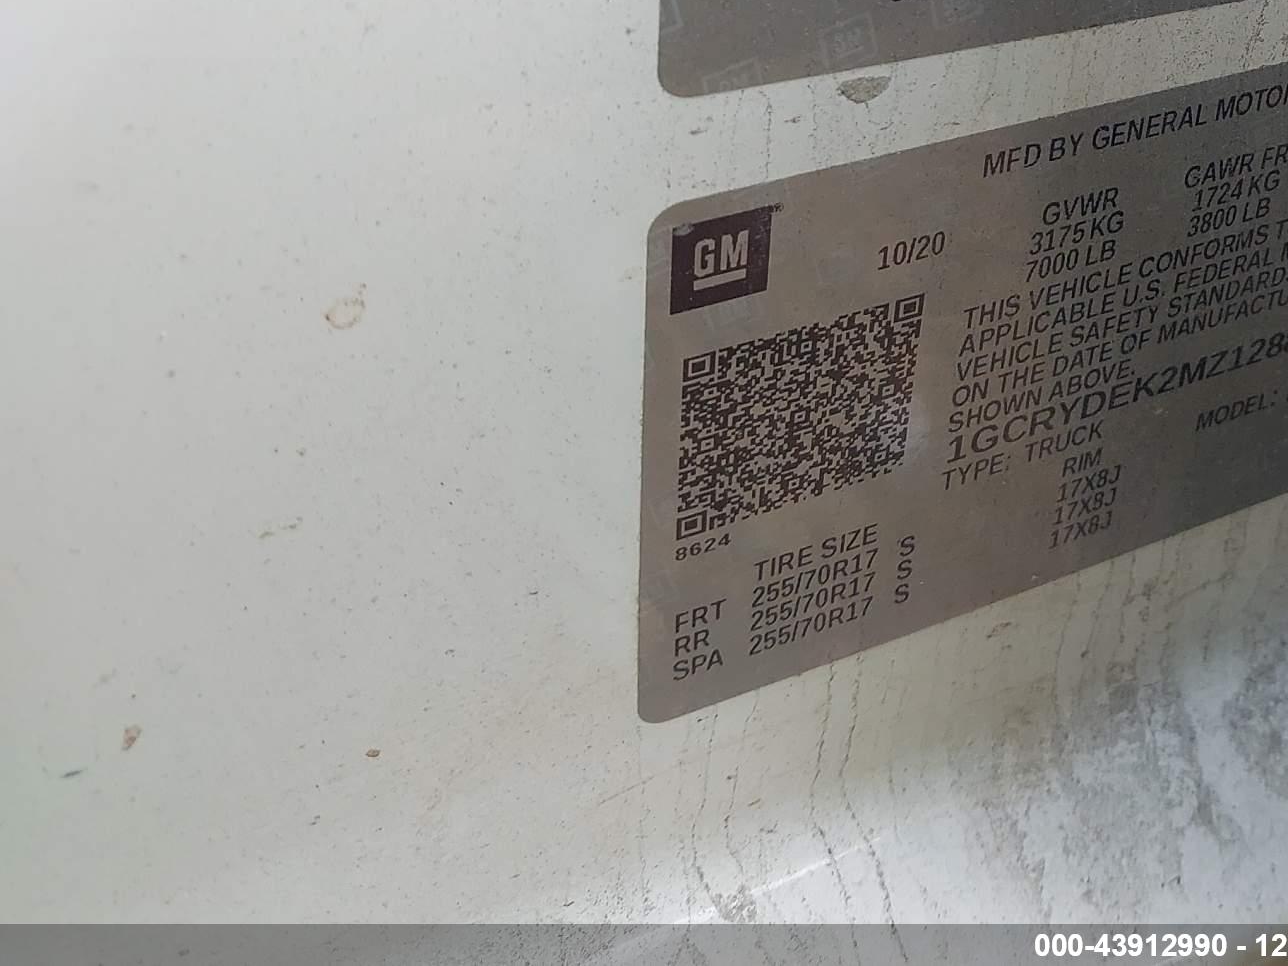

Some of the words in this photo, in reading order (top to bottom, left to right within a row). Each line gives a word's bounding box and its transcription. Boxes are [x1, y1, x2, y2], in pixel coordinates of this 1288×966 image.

[983, 143, 1042, 179] MFD
[1048, 133, 1085, 164] BY
[1092, 107, 1206, 150] GENERAL
[1029, 220, 1085, 256] 3175
[1089, 210, 1124, 240] KG
[1193, 177, 1245, 212] 1724
[1248, 169, 1281, 196] KG
[1042, 186, 1120, 227] GVWR
[1183, 153, 1254, 188] GAWR
[693, 229, 749, 278] GM
[877, 231, 946, 271] 10/20
[963, 301, 1021, 331] THIS
[1028, 263, 1134, 308] VEHICLE
[1138, 224, 1274, 277] CONFORMS
[1024, 249, 1080, 284] 7000
[1084, 239, 1117, 266] LB
[1187, 204, 1238, 237] 3800
[1242, 197, 1271, 221] LB
[955, 331, 1065, 383] VEHICLE
[1068, 303, 1159, 349] SAFETY
[959, 301, 1116, 358] APPLICABLE
[1124, 278, 1168, 306] U.S.
[1174, 247, 1274, 295] FEDERAL
[947, 389, 1044, 433] SHOWN
[1048, 361, 1136, 401] ABOVE.
[951, 379, 988, 409] ON
[1001, 362, 1048, 394] THE
[1052, 342, 1114, 377] DATE
[1120, 332, 1153, 355] OF
[941, 453, 1012, 491] TYPE:
[1025, 420, 1104, 464] TRUCK
[1194, 390, 1278, 432] MODEL:
[675, 533, 731, 561] 8624
[675, 599, 727, 632] FRT
[751, 548, 879, 608] 255/70R17
[900, 535, 916, 556] S
[1056, 465, 1122, 502] 17X8J
[753, 548, 813, 582] TIRE
[821, 524, 879, 556] SIZE
[1061, 448, 1103, 478] RIM
[673, 650, 725, 681] SPA
[749, 598, 874, 656] 255/70R17
[894, 583, 911, 604] S
[1047, 510, 1113, 550] 17X8J
[674, 629, 711, 657] RR
[750, 574, 875, 632] 255/70R17
[896, 560, 913, 580] S
[1052, 487, 1117, 526] 17X8J
